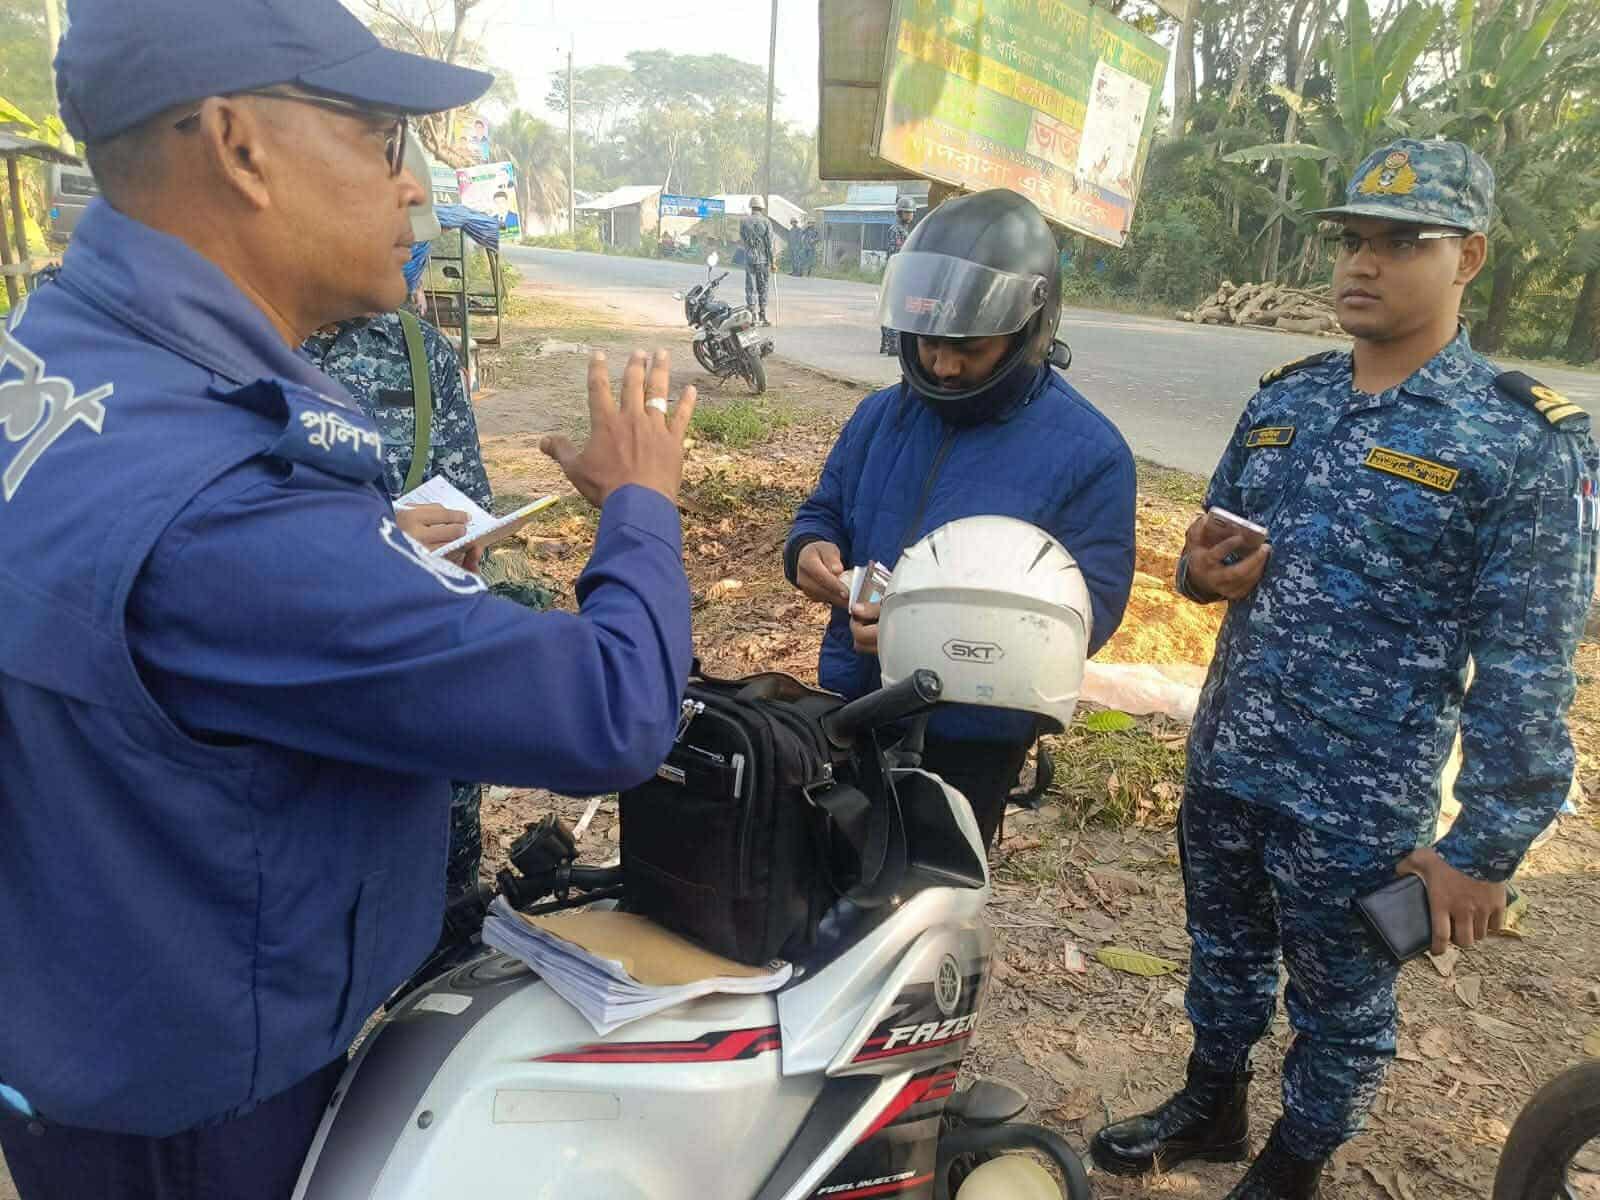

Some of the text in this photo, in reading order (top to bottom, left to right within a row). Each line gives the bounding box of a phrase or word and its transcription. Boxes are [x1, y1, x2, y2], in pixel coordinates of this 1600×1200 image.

[300, 410, 383, 460] পুলিশ
[951, 644, 995, 659] SKT
[881, 1011, 977, 1050] FAZER
[817, 1182, 856, 1195] FUEL
